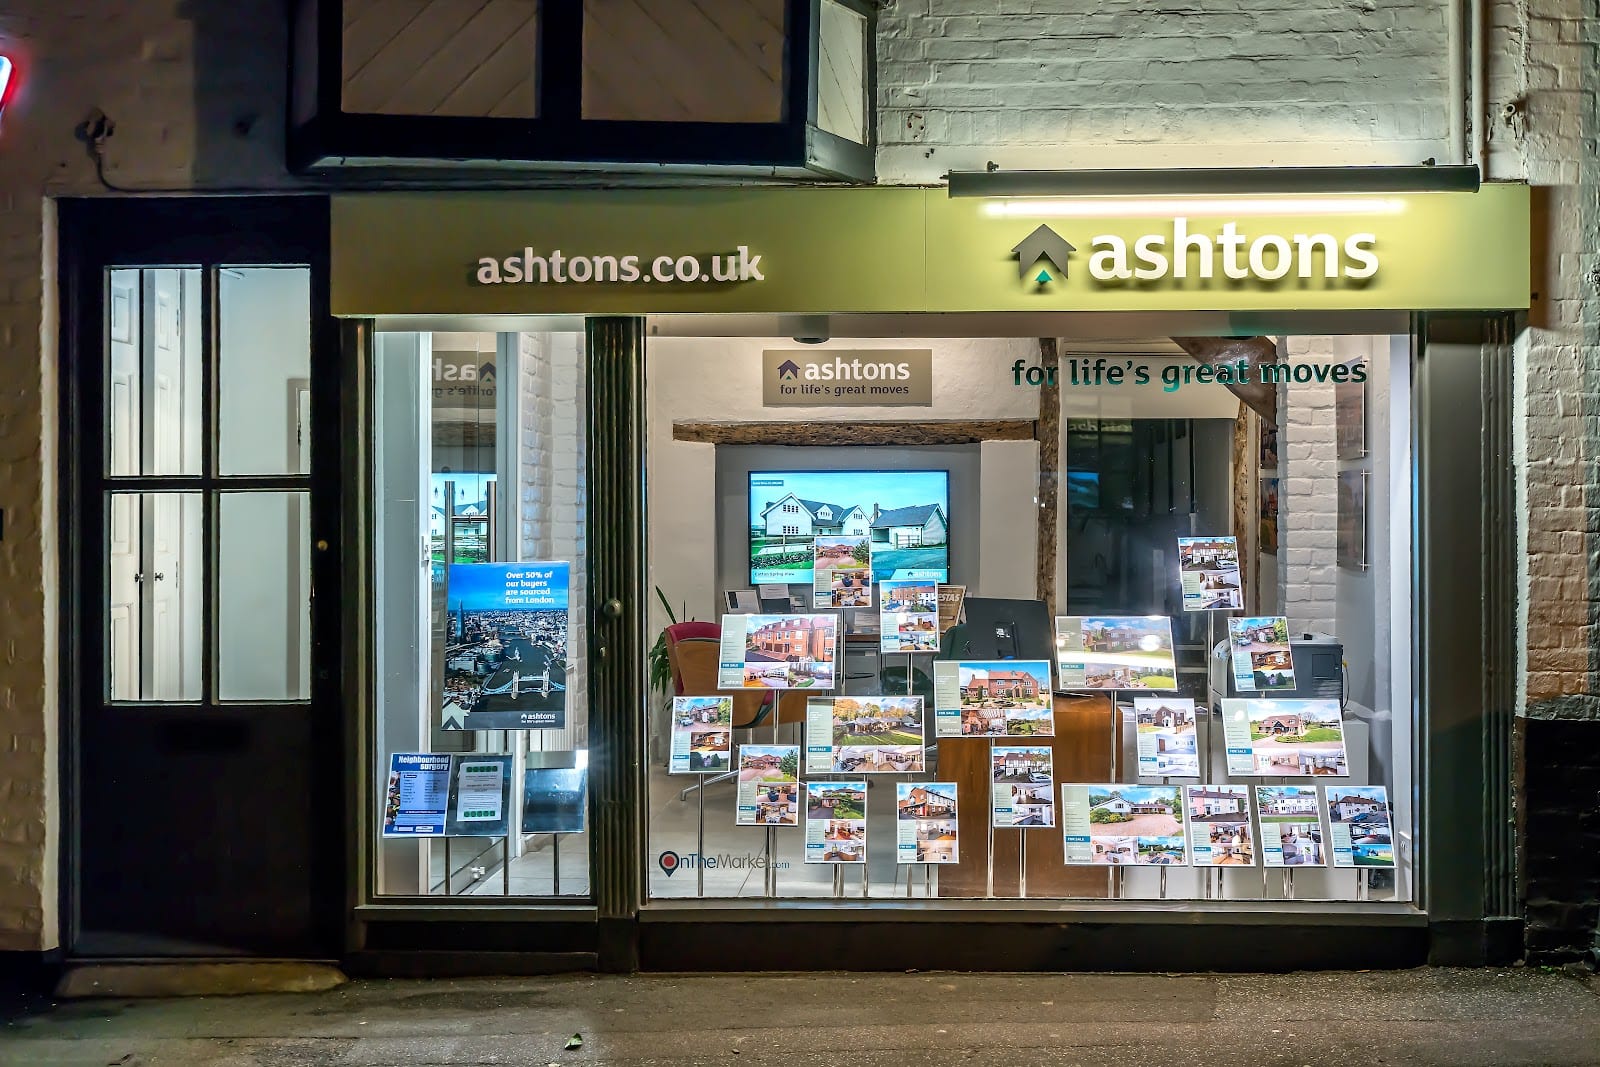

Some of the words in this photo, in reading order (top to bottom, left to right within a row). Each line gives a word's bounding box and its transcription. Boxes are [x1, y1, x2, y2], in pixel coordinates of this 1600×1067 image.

[1089, 217, 1379, 280] ashtons
[477, 246, 764, 283] ashtons.co.uk
[804, 357, 910, 380] ashtons
[1012, 360, 1058, 385] for
[1161, 360, 1249, 393] great
[1260, 362, 1368, 384] moves
[780, 384, 797, 395] for
[801, 384, 830, 395] life's
[834, 385, 866, 397] great
[870, 386, 909, 395] moves
[544, 571, 553, 579] of
[520, 580, 548, 588] buyers
[398, 755, 449, 764] Neighbourhood
[420, 763, 448, 771] surgery
